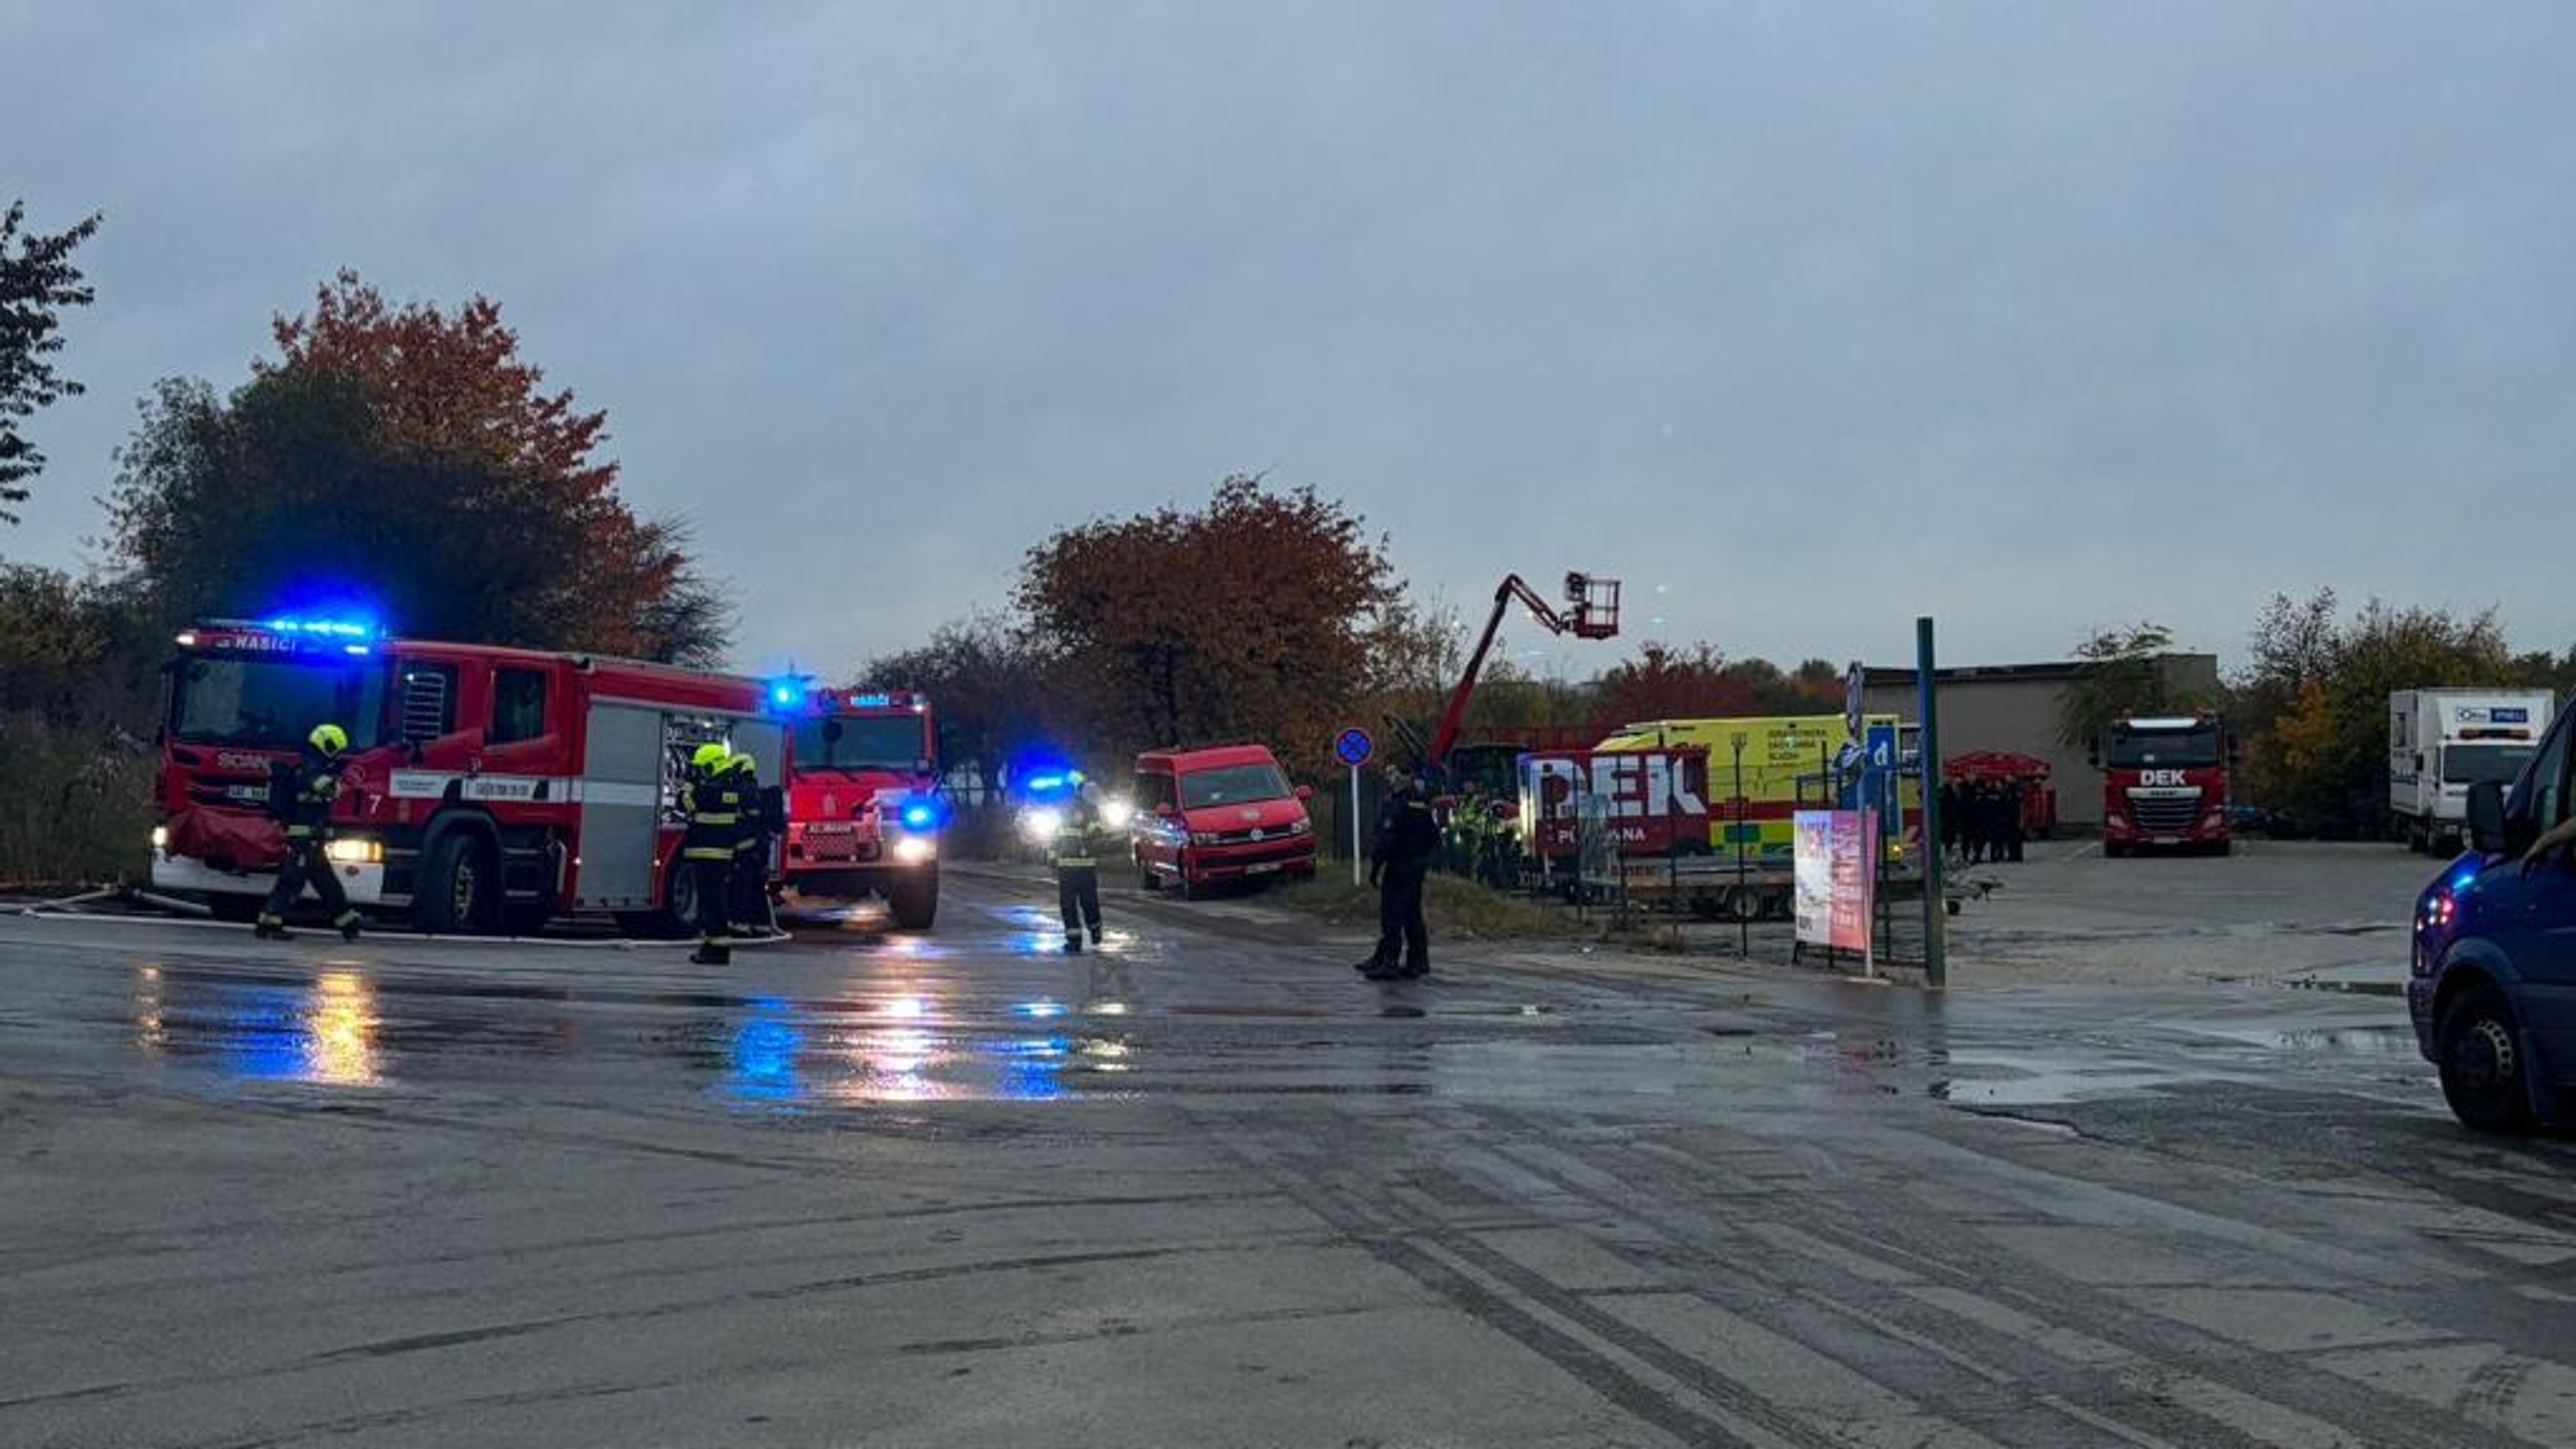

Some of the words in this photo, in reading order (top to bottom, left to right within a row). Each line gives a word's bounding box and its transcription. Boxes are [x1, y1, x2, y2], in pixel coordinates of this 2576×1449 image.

[1529, 755, 1708, 820] DEK
[2140, 768, 2187, 786] DEK
[369, 794, 382, 815] 7
